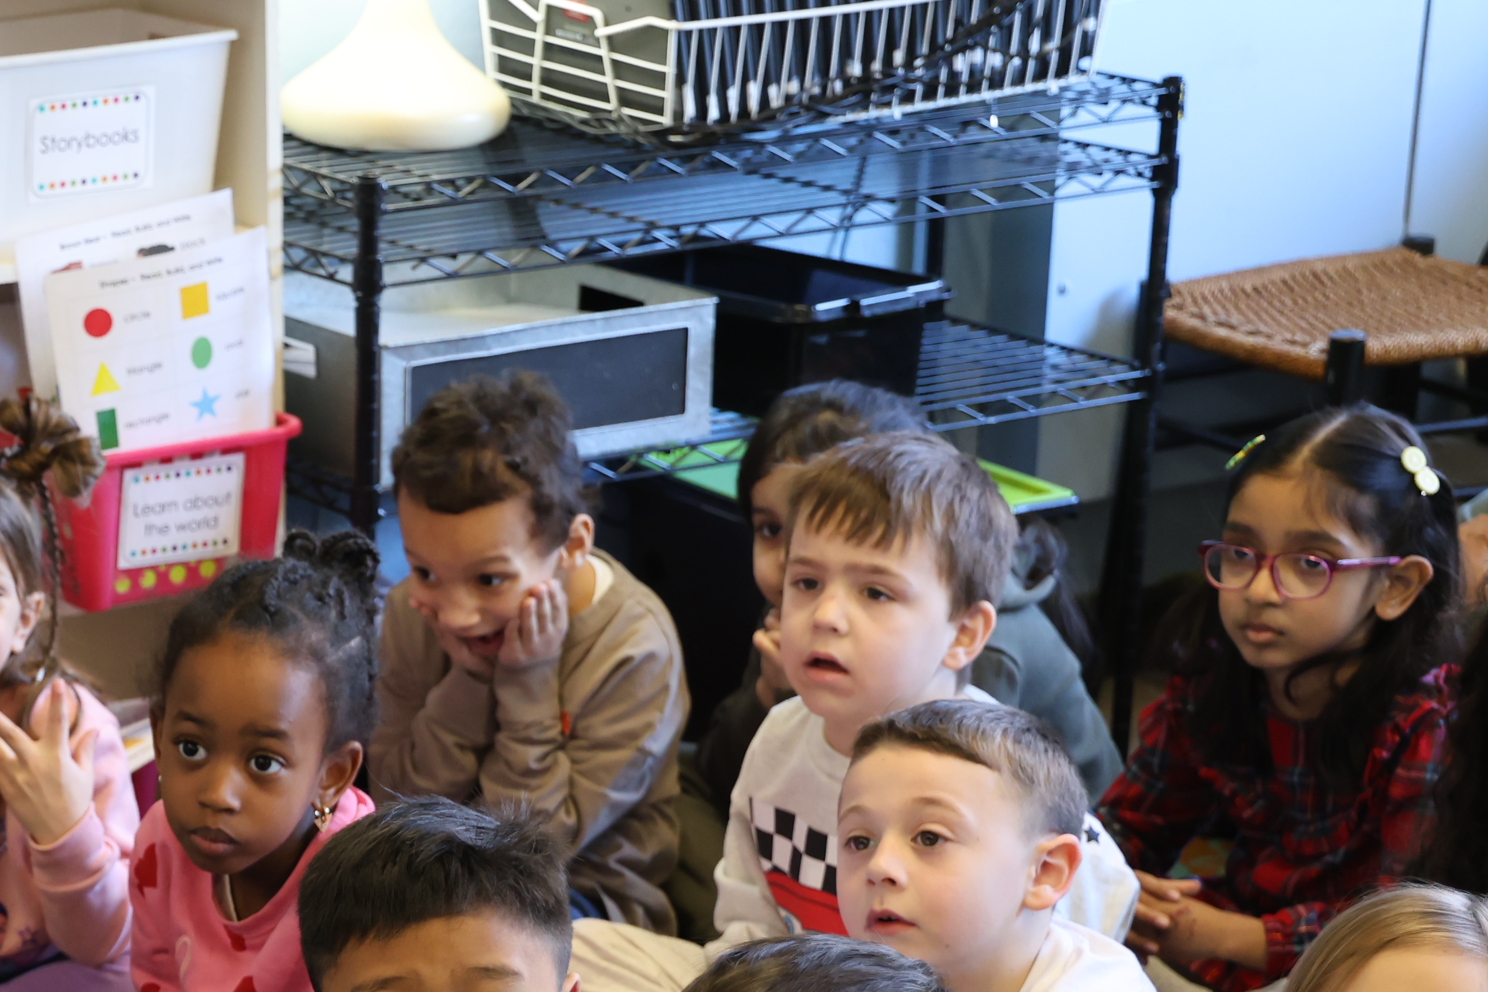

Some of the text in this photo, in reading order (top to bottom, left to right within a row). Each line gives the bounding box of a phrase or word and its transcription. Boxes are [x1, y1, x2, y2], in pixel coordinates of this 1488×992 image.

[39, 127, 140, 154] Storybooks
[132, 492, 233, 519] Learn about
[144, 516, 220, 538] the world
